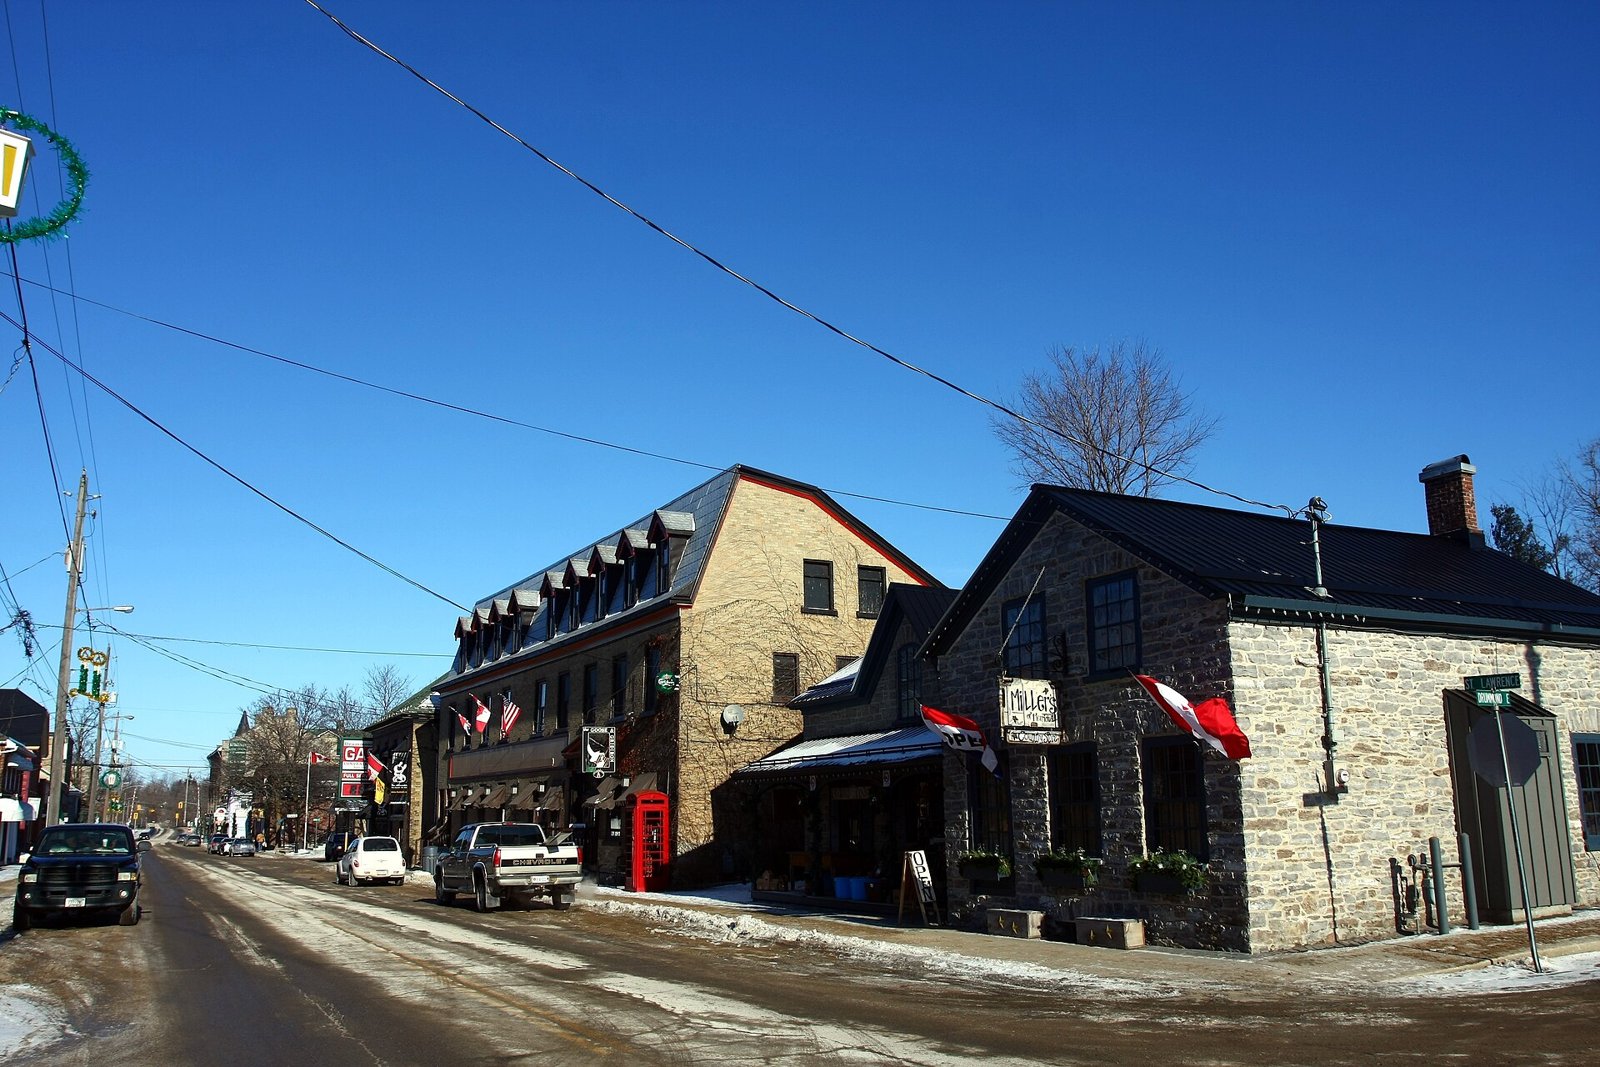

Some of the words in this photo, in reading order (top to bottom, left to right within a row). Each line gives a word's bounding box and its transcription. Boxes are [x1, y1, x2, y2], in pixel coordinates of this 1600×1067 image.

[1481, 676, 1520, 688] LAWRENCE
[1477, 692, 1503, 704] DRUMMOND
[1506, 693, 1510, 704] E
[913, 852, 933, 901] OPEN
